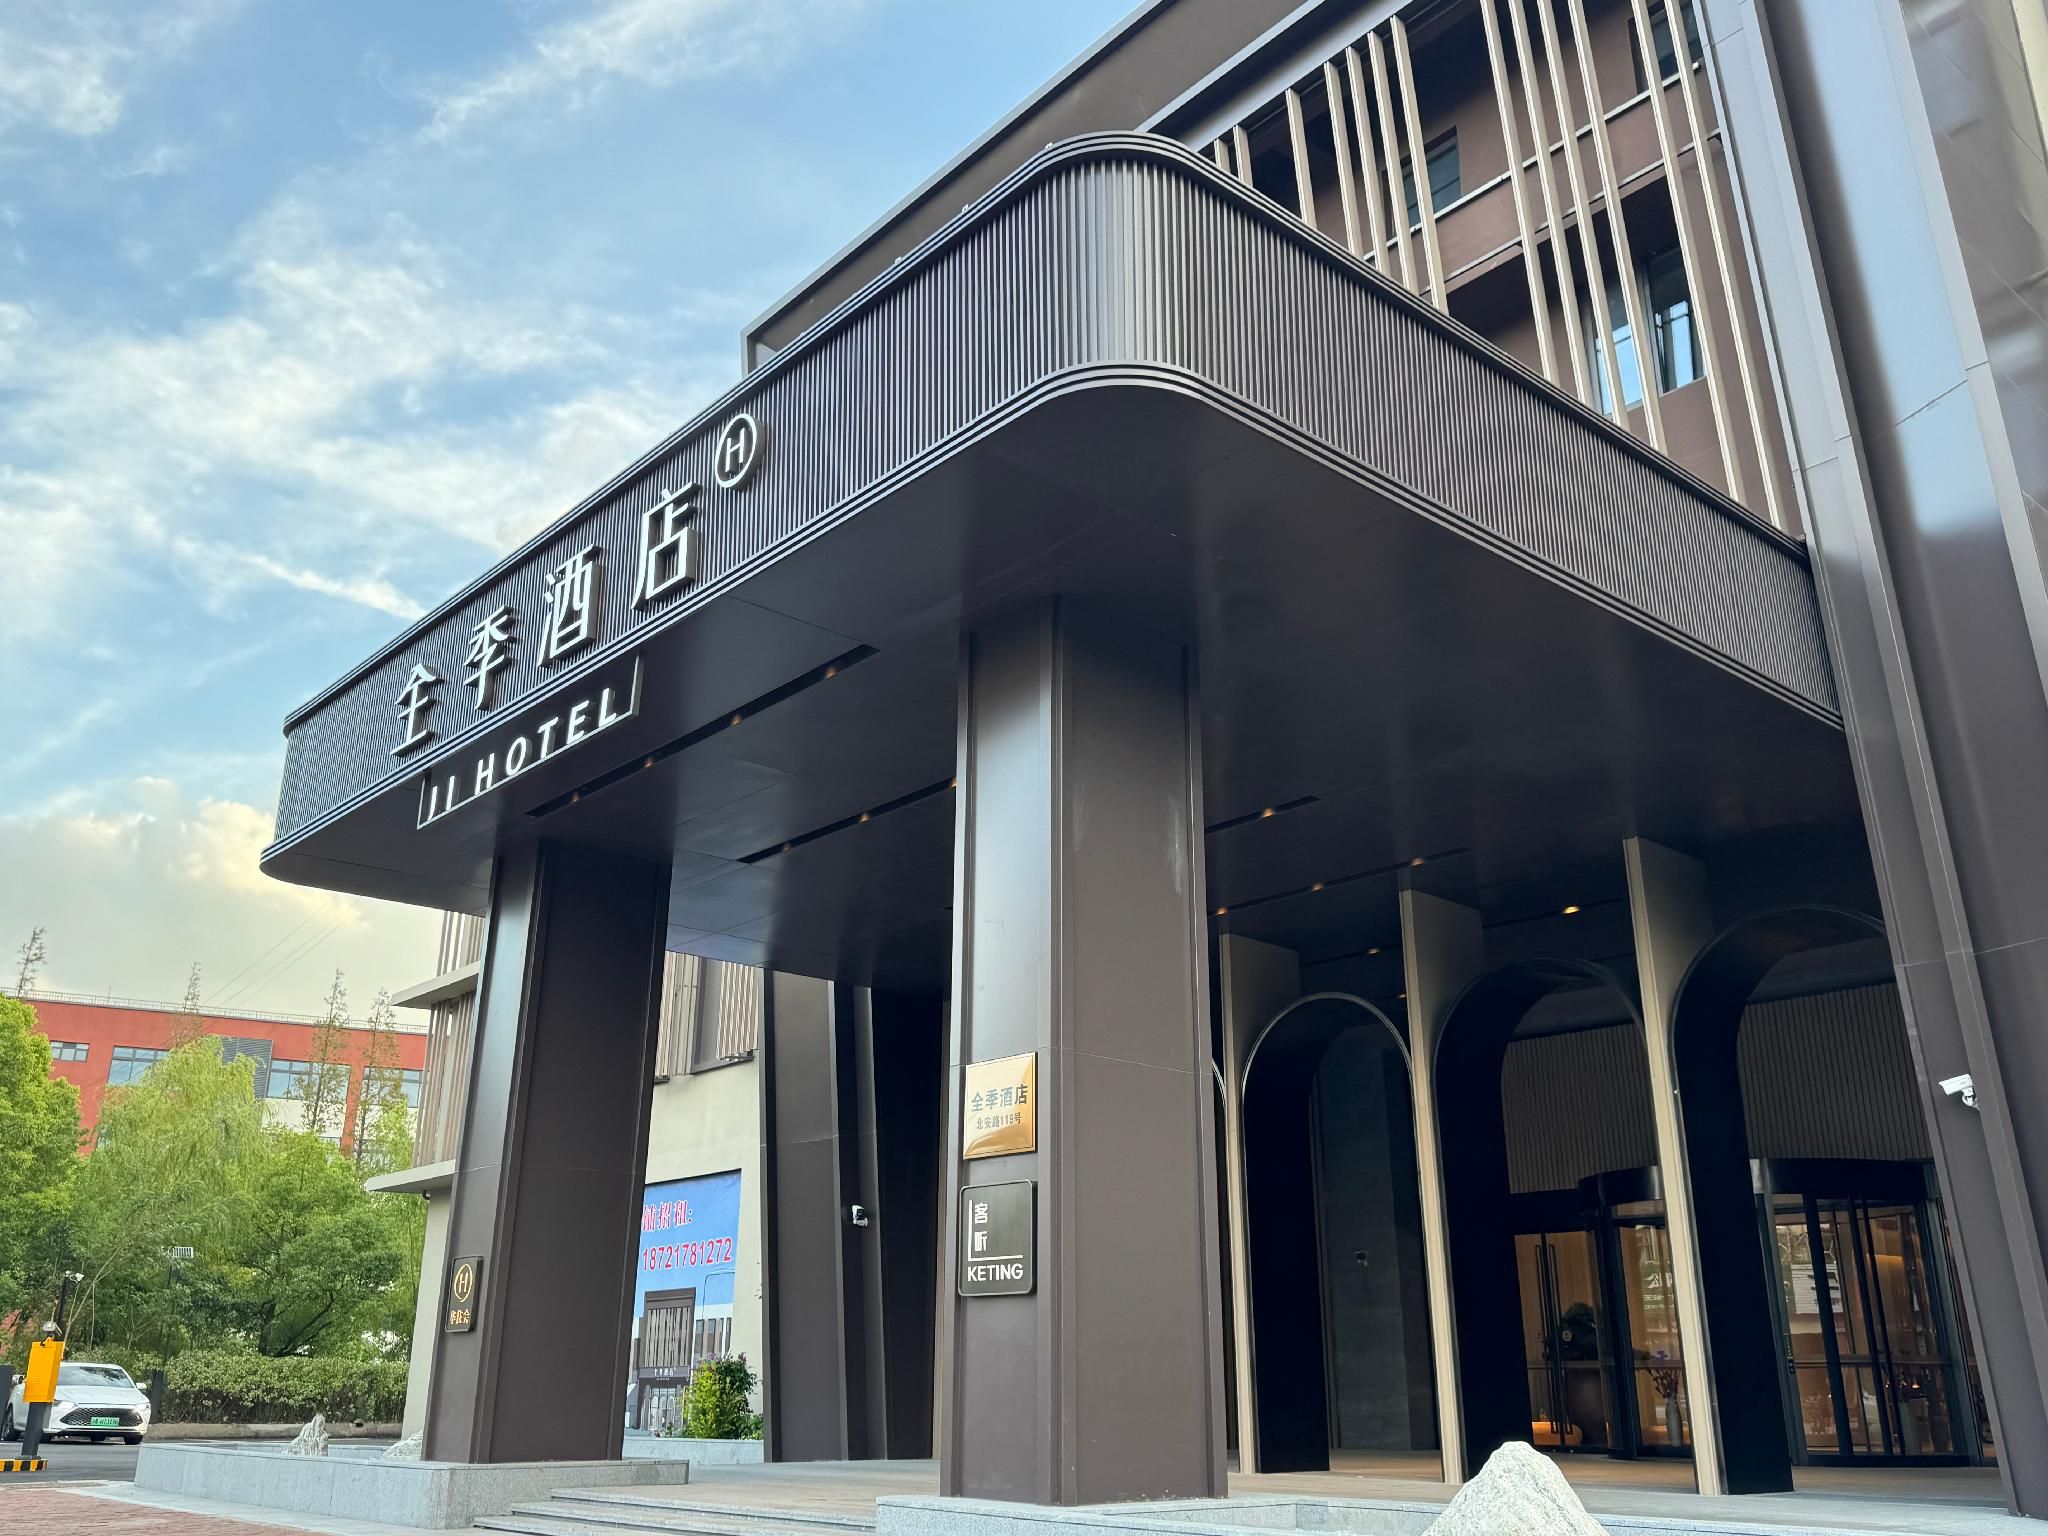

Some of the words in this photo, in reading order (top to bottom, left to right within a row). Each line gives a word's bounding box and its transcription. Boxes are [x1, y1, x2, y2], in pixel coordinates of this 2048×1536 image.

[390, 481, 700, 757] 全季酒店
[474, 687, 618, 797] HOTEL
[971, 1083, 1028, 1112] 全季酒店
[976, 1111, 1022, 1130] 北安路118号
[642, 1237, 733, 1271] 18721781272
[967, 1263, 1024, 1282] KETING
